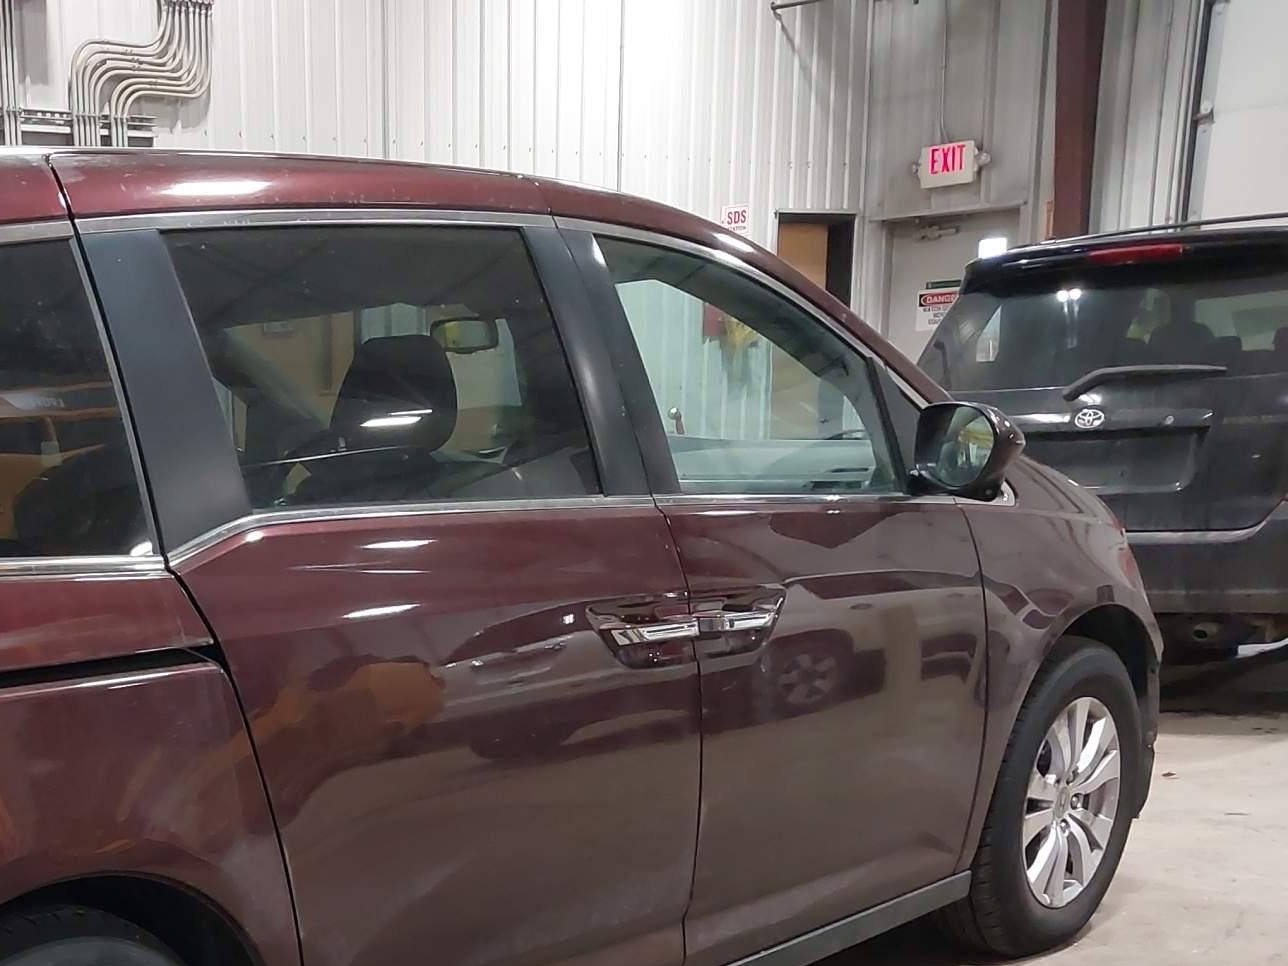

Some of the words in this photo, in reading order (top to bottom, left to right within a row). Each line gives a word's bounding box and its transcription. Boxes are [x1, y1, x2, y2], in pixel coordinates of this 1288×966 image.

[930, 144, 966, 174] EXIT
[727, 210, 747, 225] SDS
[926, 294, 956, 304] DANGE
